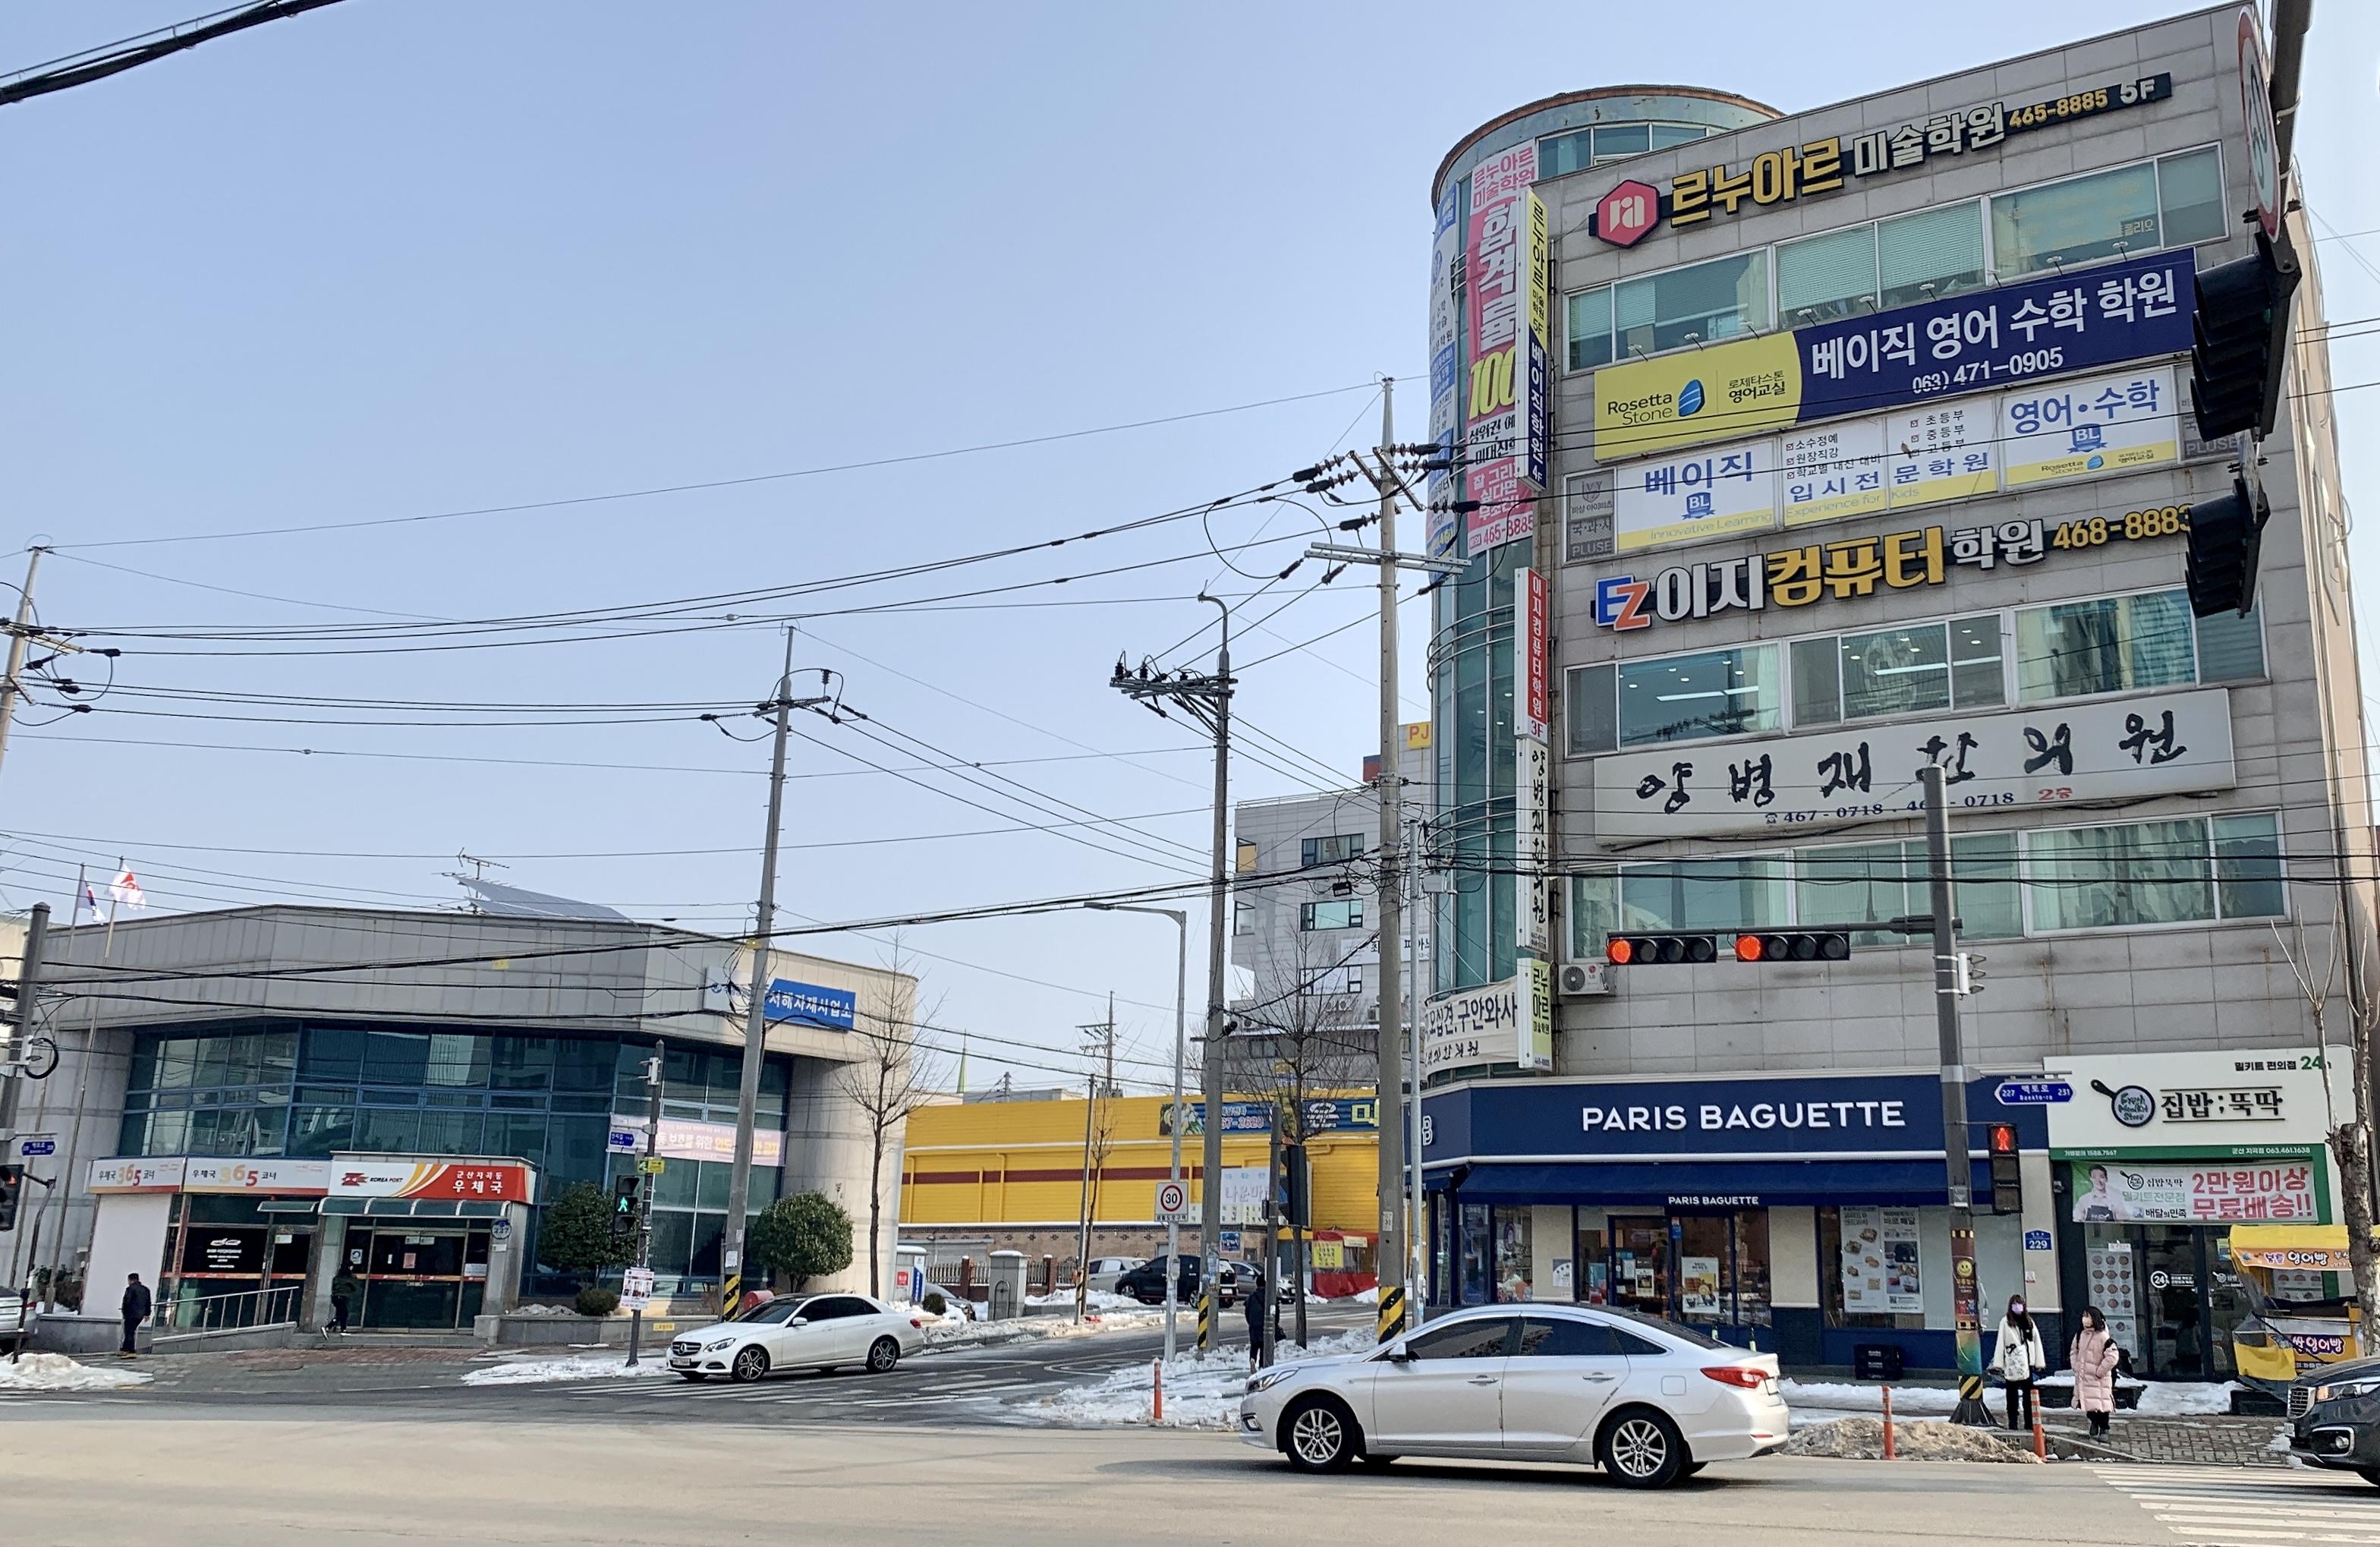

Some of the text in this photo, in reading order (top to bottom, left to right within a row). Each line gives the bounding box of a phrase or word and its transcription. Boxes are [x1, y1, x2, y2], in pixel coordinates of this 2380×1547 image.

[1670, 77, 2155, 228] 르누아르 미술학원 465-8885 5F
[1474, 146, 1535, 187] 르누아르
[1472, 166, 1536, 209] 미술학원
[1532, 200, 1545, 293] 르누아르
[1478, 199, 1518, 354] 합격률
[1532, 317, 1543, 335] 5F
[1812, 268, 2177, 381] 베이직 영어 수학 학원
[1954, 346, 2064, 389] 471-0905
[1727, 370, 1784, 389] 로제타스톤
[1728, 380, 1786, 405] 영어교실
[1531, 342, 1545, 465] 베이직학원
[1607, 392, 1673, 416] Rosetta
[1622, 407, 1673, 426] Stone
[1925, 410, 1963, 427] 초등부
[1795, 433, 1838, 451] 소수정예
[1925, 425, 1966, 442] 중등부
[2076, 427, 2098, 441] BL
[1796, 447, 1839, 465] 원장직강
[1644, 451, 1752, 496] 베이직
[2041, 462, 2084, 472] Rosetta
[1689, 495, 1710, 512] BL
[1785, 499, 1859, 519] Experience
[1716, 512, 1773, 531] Learning
[1572, 540, 1612, 557] PLUSE
[1950, 518, 2047, 570] 학원
[1596, 574, 1651, 631] EZ
[1532, 575, 1543, 718] 이지컴퓨터학원
[1531, 720, 1543, 738] 3F
[769, 990, 852, 1019] 서해자재사업소
[2234, 1062, 2265, 1071] 밀키트
[2266, 1060, 2297, 1071] 편의점
[2002, 1089, 2015, 1098] 227
[1582, 1101, 1906, 1132] PARIS BAGUETTE
[99, 1164, 155, 1186] 우체국 365 코너
[192, 1164, 276, 1186] 우체국 365 코너
[2192, 1167, 2309, 1195] 2만원이상
[452, 1180, 503, 1194] 우체국
[1166, 1194, 1177, 1204] 30
[1668, 1196, 1759, 1205] PARIS BAGUETTE
[2193, 1193, 2312, 1221] 무료배송!!
[2145, 1208, 2187, 1218] 배달의민족
[2029, 1240, 2048, 1249] 229
[2287, 1251, 2329, 1265] 잉어빵
